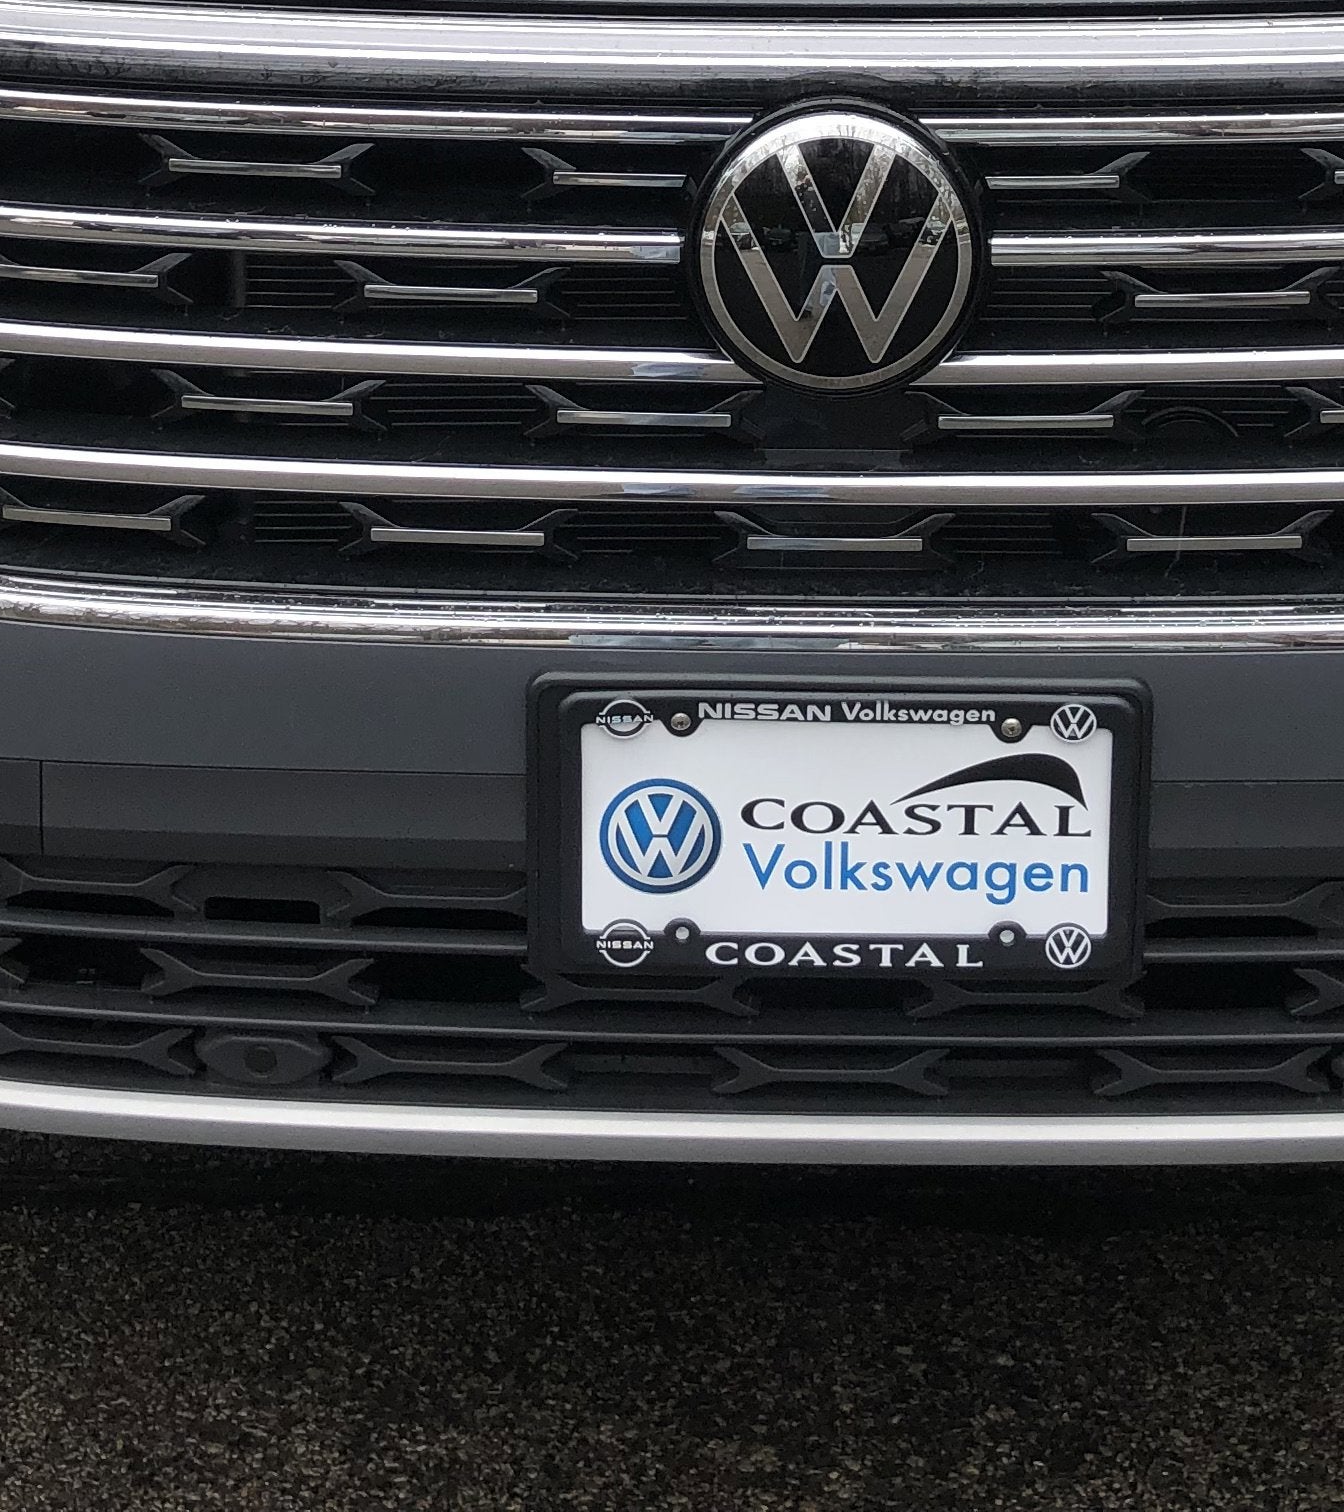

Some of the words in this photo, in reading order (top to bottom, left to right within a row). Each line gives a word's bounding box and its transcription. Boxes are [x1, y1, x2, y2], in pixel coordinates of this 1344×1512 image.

[596, 714, 654, 725] NISSAN
[698, 702, 832, 722] NISSAN
[841, 700, 996, 726] Volkswagen
[740, 798, 1092, 838] COASTAL
[742, 841, 1091, 906] Volkswagen
[596, 940, 654, 949] NISSAN
[705, 940, 984, 968] COASTAL
